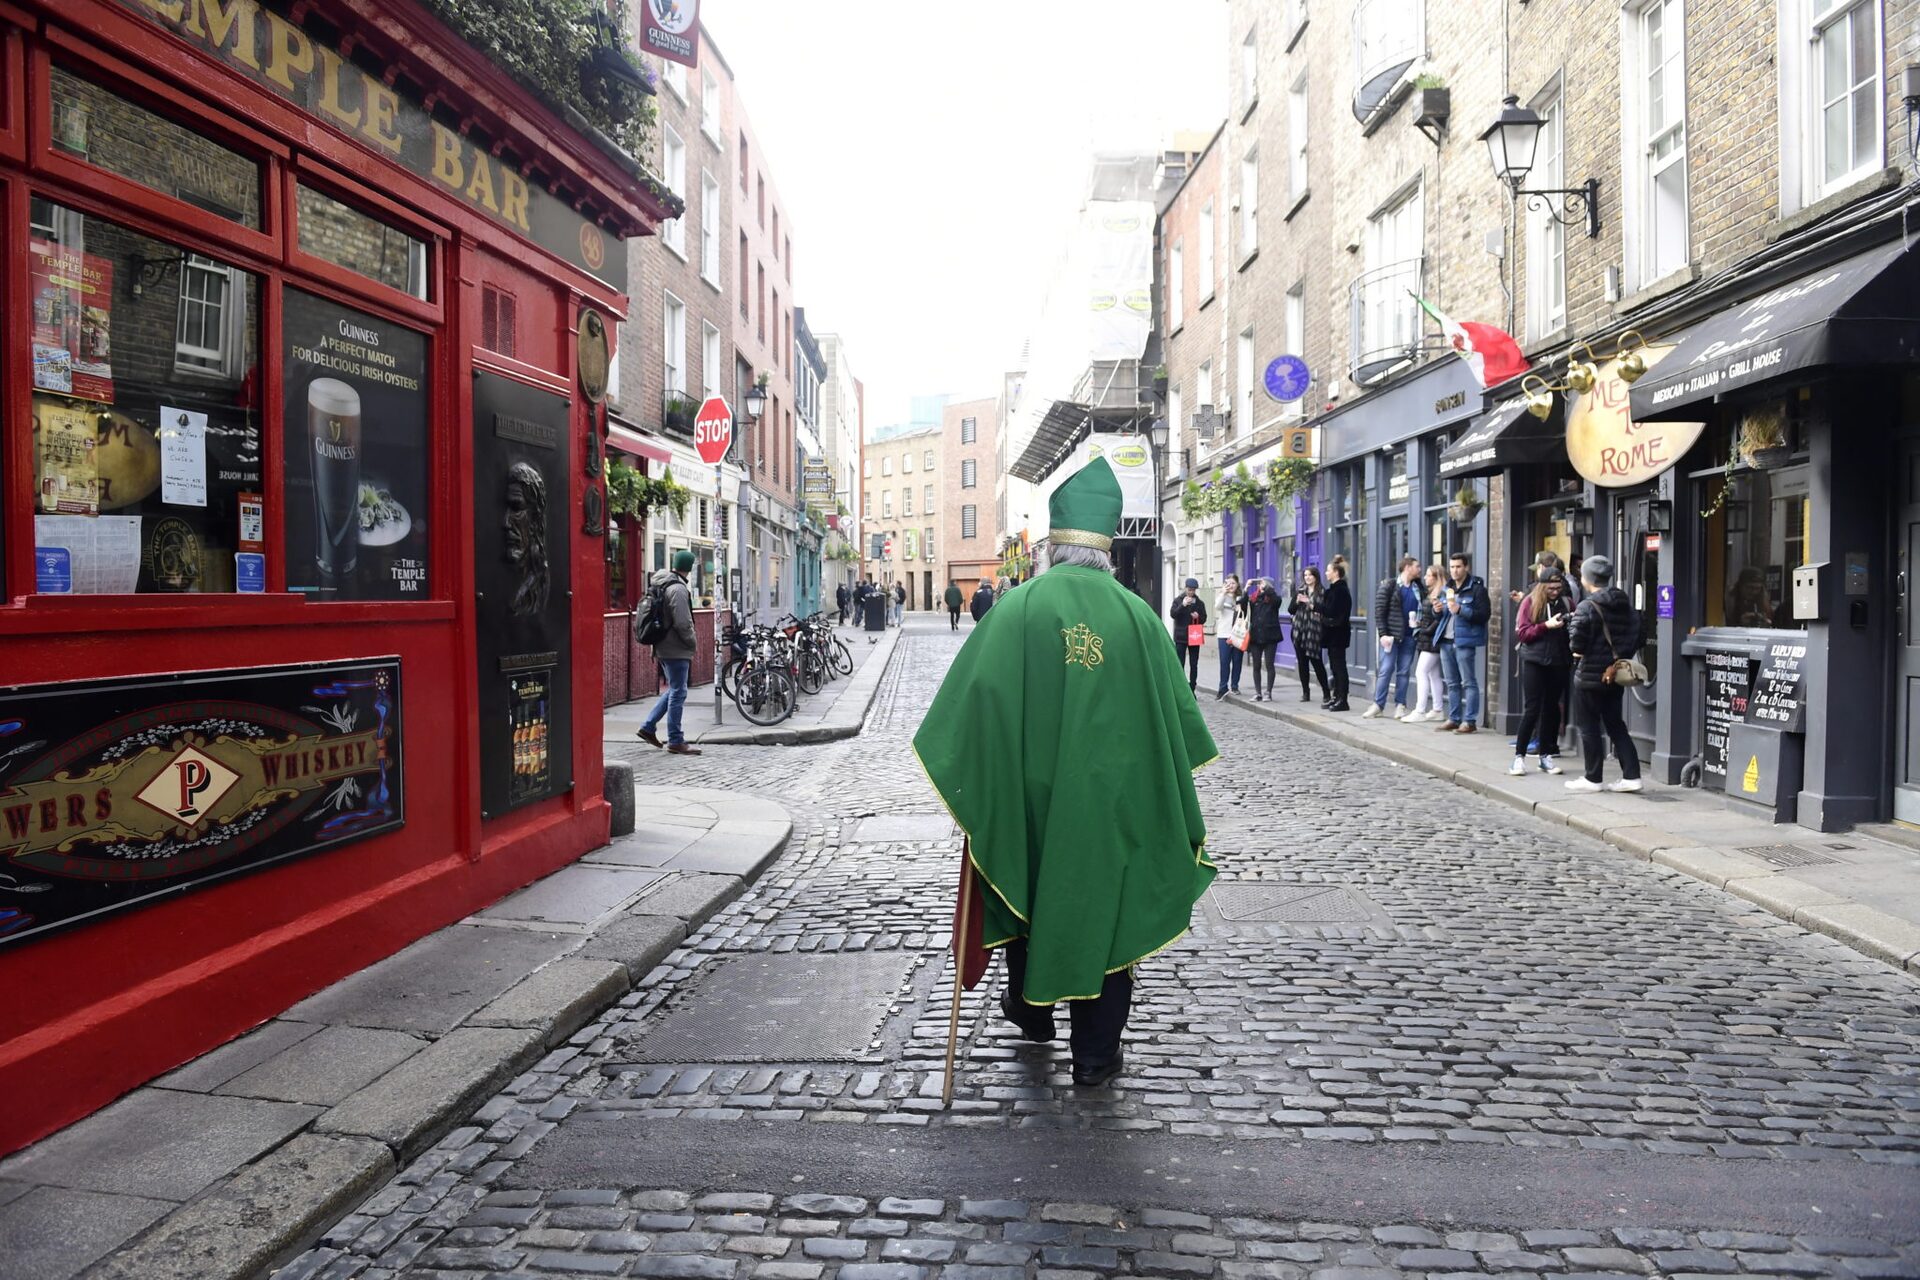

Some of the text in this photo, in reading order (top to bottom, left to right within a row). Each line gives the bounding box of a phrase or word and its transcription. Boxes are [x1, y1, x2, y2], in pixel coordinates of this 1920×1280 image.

[649, 27, 690, 50] GUINNESS
[431, 119, 531, 232] BAR
[583, 227, 601, 261] 48
[40, 255, 81, 274] TEMPLE
[83, 267, 103, 281] BAR
[64, 253, 81, 264] THE
[339, 319, 379, 346] GUINNESS
[320, 335, 396, 368] A PERFECT MATCH
[292, 345, 418, 391] FOR DELICIOUS IRISH OYSTERS
[1652, 347, 1783, 404] MEXICAN ITALIAN GRILL HOUSE
[696, 418, 730, 445] STOP
[315, 437, 356, 460] GUINNESS
[1600, 436, 1669, 477] ROME
[391, 567, 425, 580] TEMPLE
[401, 558, 415, 568] THE
[400, 580, 418, 591] BAR
[1754, 690, 1762, 703] 2
[174, 758, 211, 817] P
[260, 740, 367, 787] WHISKEY
